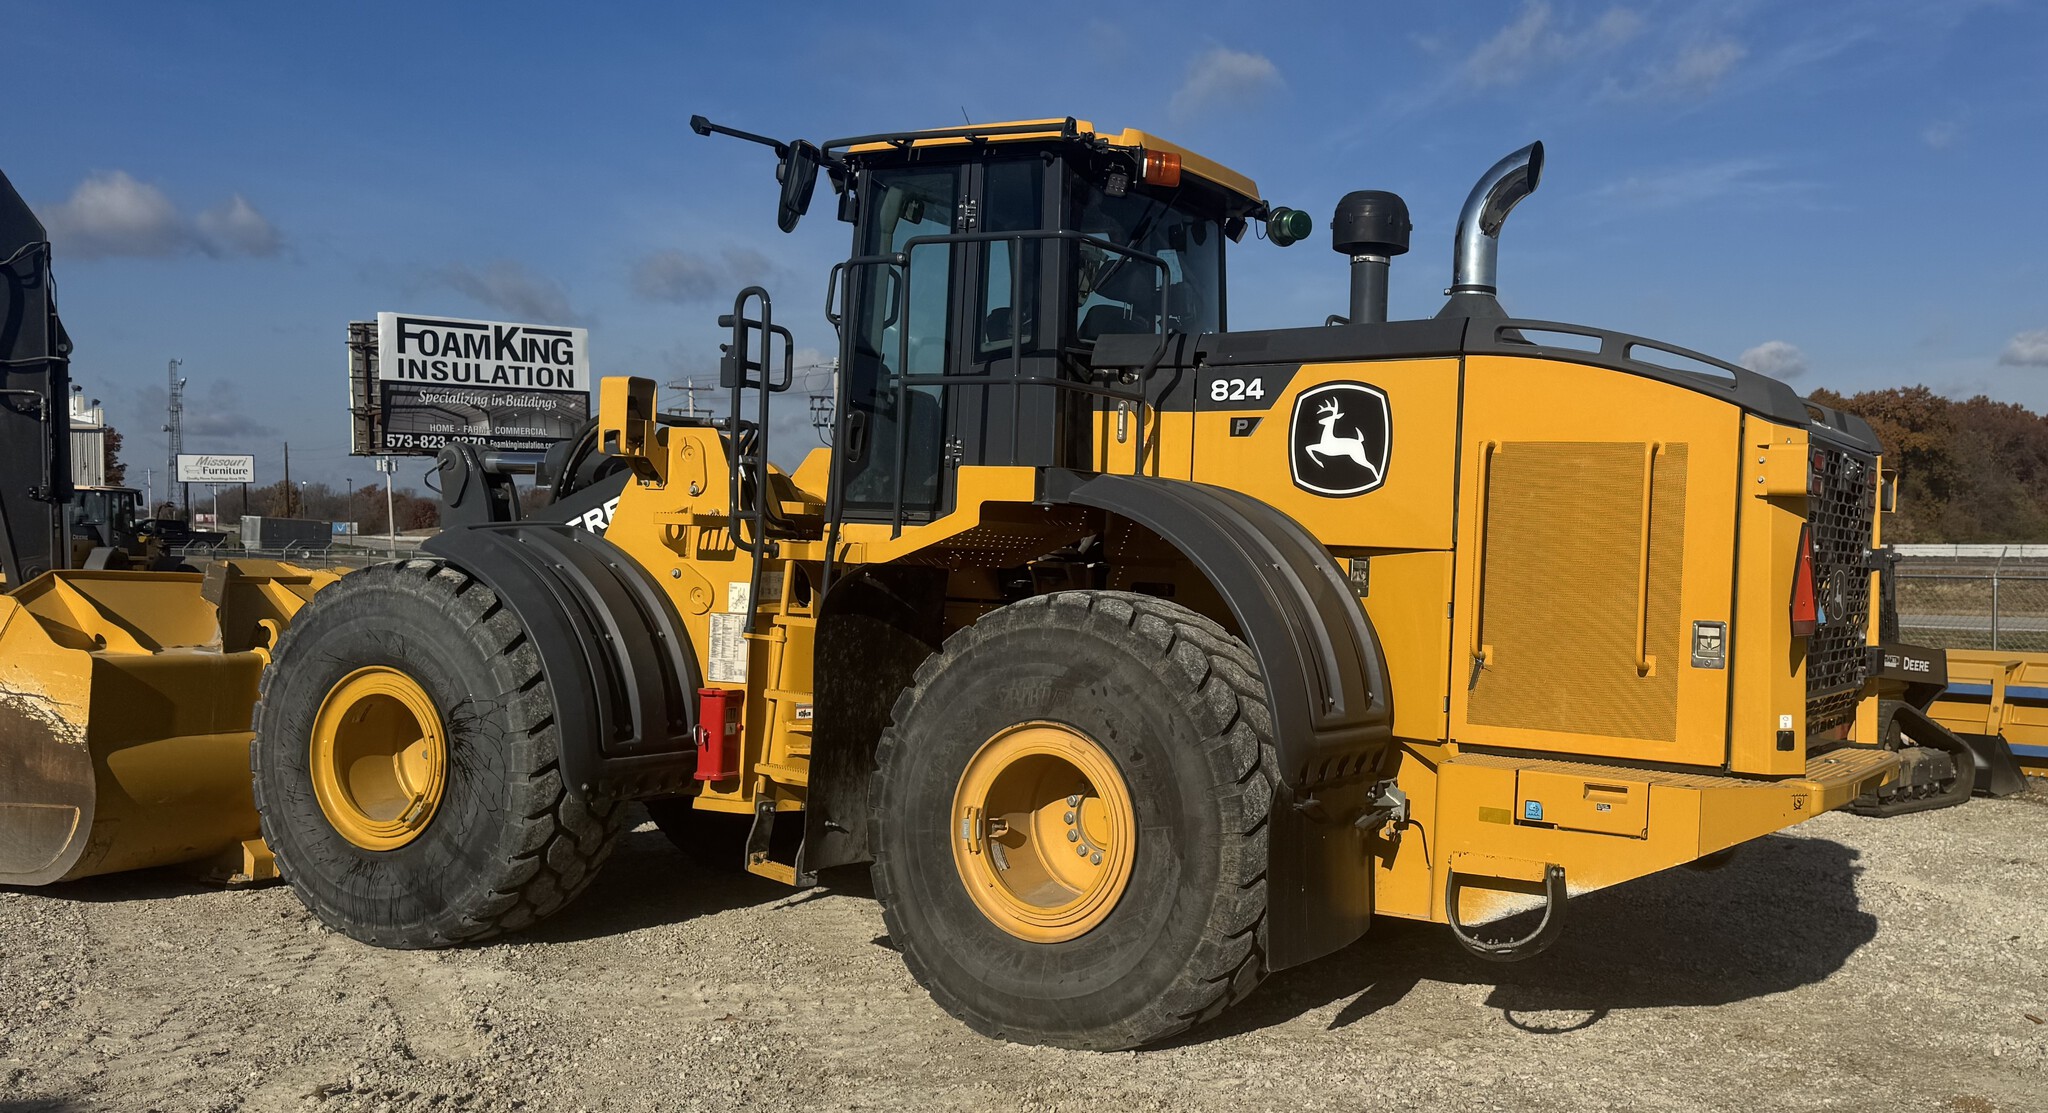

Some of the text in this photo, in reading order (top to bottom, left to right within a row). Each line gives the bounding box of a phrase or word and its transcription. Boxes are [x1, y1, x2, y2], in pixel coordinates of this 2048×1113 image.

[397, 358, 574, 388] INSULATION
[1210, 378, 1265, 402] 824
[418, 390, 557, 411] Specializing in Buildings
[430, 424, 455, 433] HOME
[463, 424, 487, 434] FARM
[495, 426, 548, 436] COMMERCIAL
[1235, 419, 1249, 435] P
[195, 456, 248, 467] Missouri
[202, 466, 248, 475] Furniture
[1903, 656, 1930, 673] DEERE
